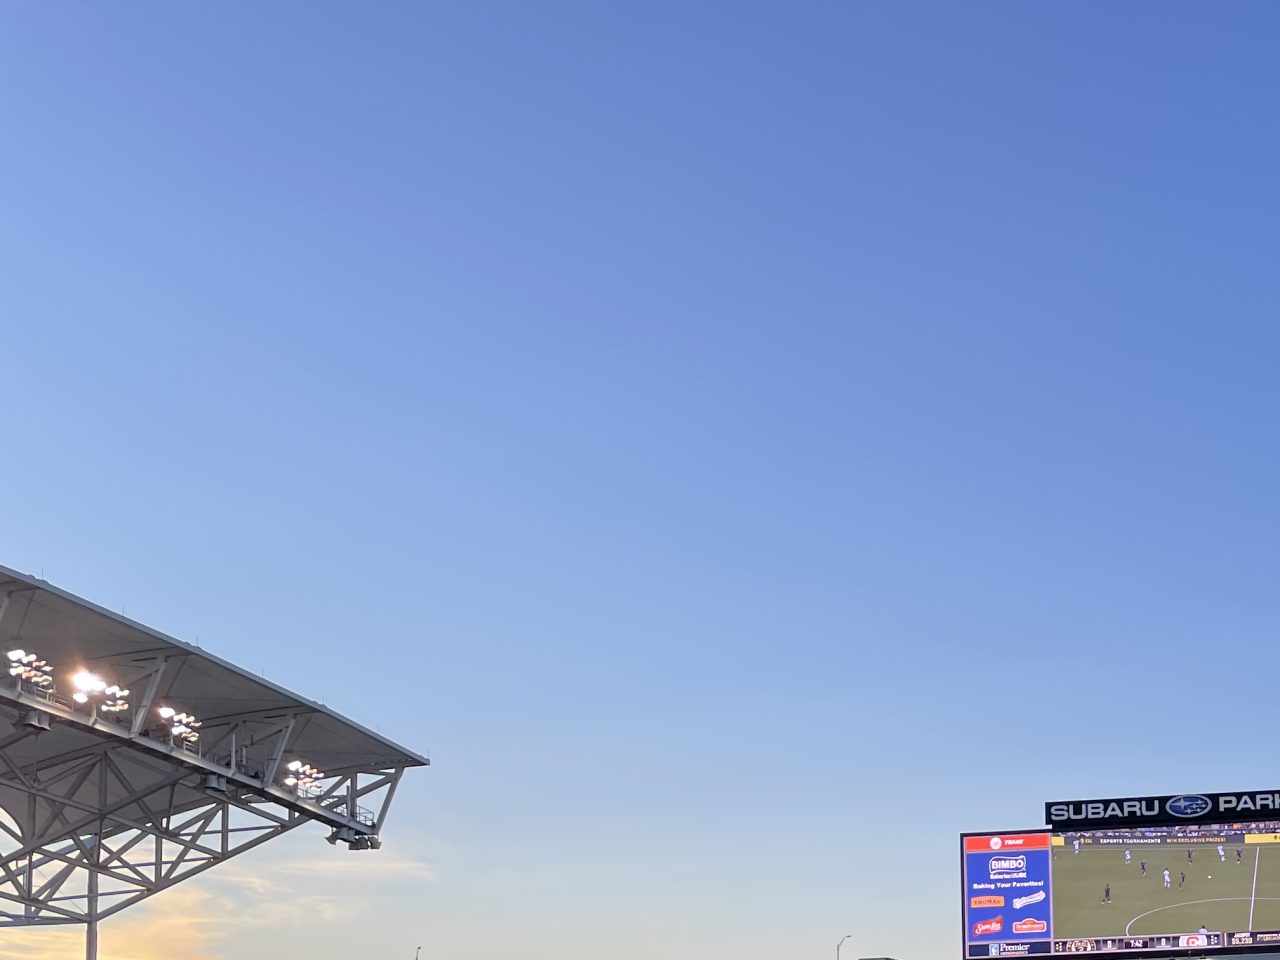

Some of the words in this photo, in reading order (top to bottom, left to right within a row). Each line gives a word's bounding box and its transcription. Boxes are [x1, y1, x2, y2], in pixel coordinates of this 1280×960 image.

[1050, 800, 1159, 820] SUBARU
[991, 860, 1024, 870] BIMBO
[999, 943, 1030, 952] Premier
[1130, 940, 1143, 948] 7:42
